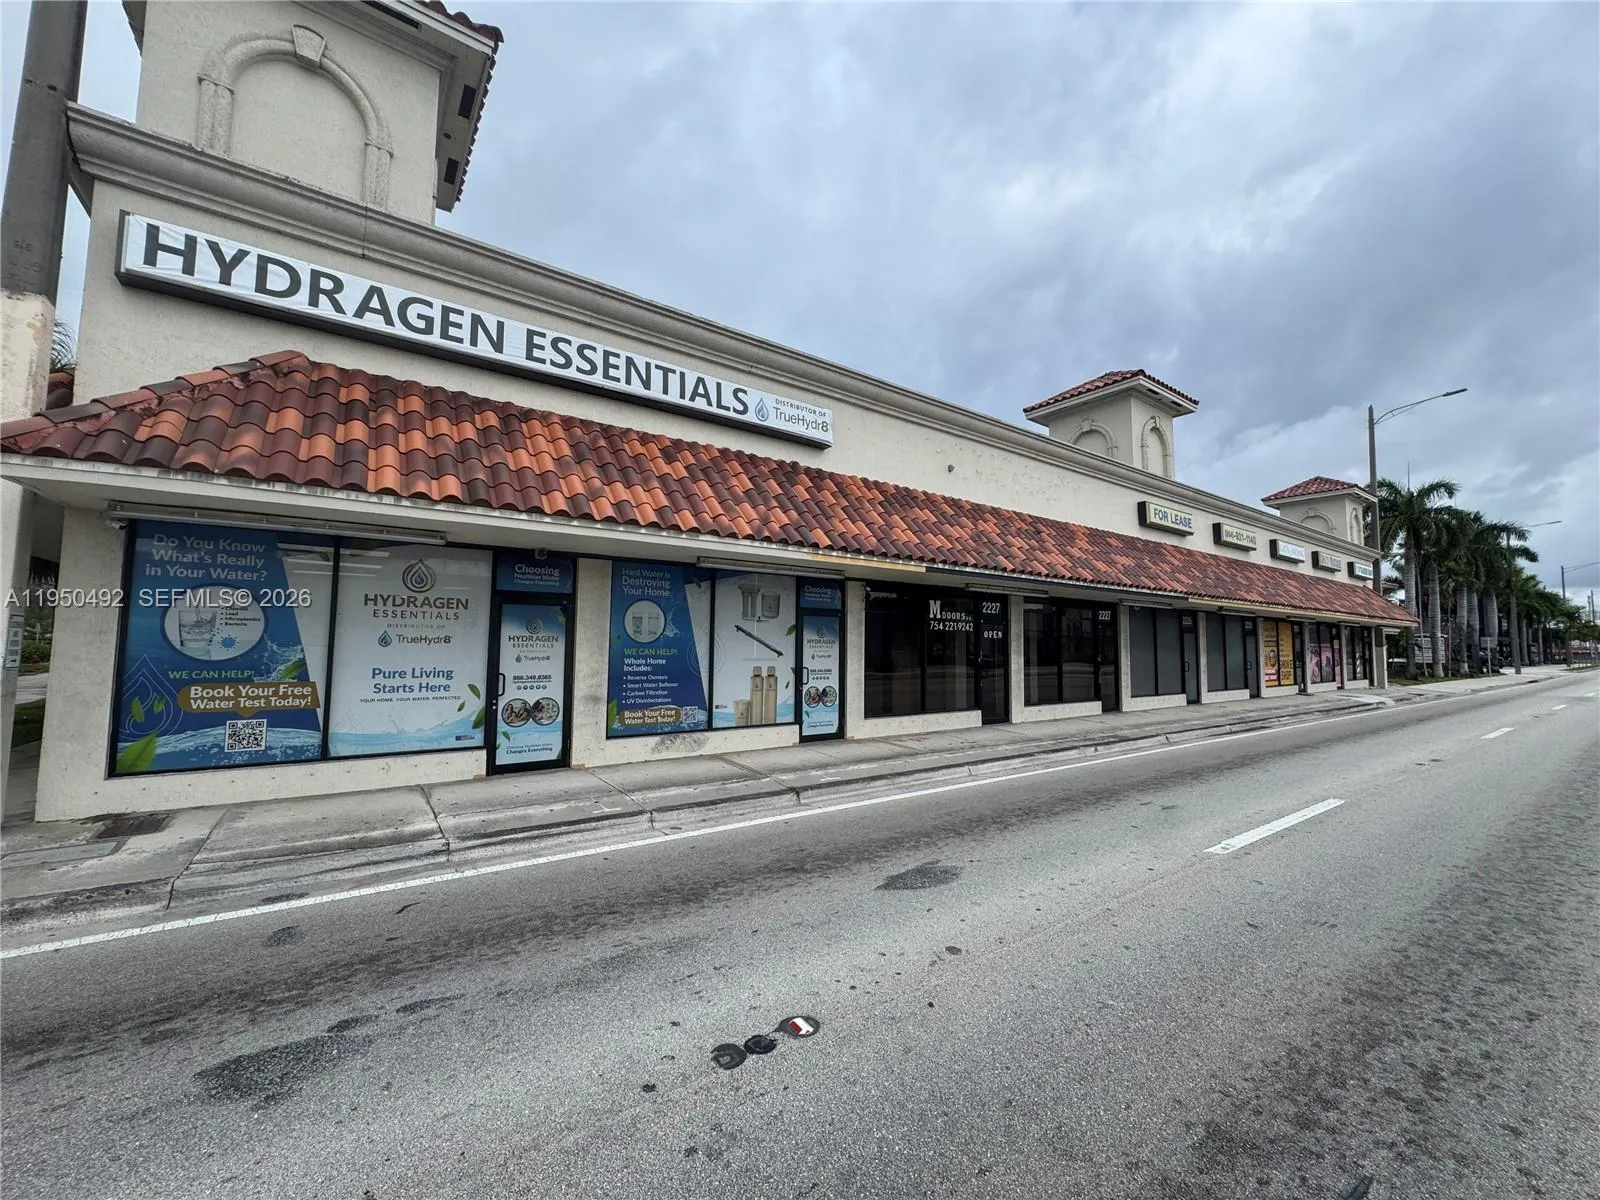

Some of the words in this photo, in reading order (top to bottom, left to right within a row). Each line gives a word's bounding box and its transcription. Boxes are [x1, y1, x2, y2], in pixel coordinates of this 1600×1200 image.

[143, 222, 505, 354] HYDRAGEN
[525, 327, 749, 416] ESSENTIALS
[775, 398, 816, 414] DISTRIBUTOR
[773, 406, 829, 433] TrueHydr8
[1153, 507, 1169, 523] FOR
[1170, 512, 1193, 529] LEASE
[153, 534, 178, 547] Do
[183, 536, 214, 549] You
[219, 539, 266, 553] Know
[151, 548, 212, 564] What's
[216, 553, 265, 568] Really
[145, 563, 161, 577] in
[166, 564, 206, 578] Your
[210, 567, 268, 582] Water?
[515, 563, 560, 576] Choosing
[622, 568, 641, 576] Hard
[641, 569, 664, 578] Water
[622, 575, 671, 589] Destroying
[622, 586, 643, 595] Your
[364, 593, 469, 610] HYDRAGEN
[982, 601, 1000, 614] 2227
[373, 608, 460, 620] ESSENTIALS
[1099, 610, 1112, 621] 2227
[396, 634, 451, 646] TrueHydr8
[983, 630, 1003, 638] OPEN
[657, 648, 678, 656] HELP!
[168, 670, 189, 679] WE
[192, 670, 219, 679] CAN
[222, 670, 255, 678] HELP!
[372, 667, 407, 679] Pure
[411, 666, 454, 680] Living
[190, 685, 234, 698] Book
[238, 685, 275, 697] Your
[279, 684, 312, 695] Free
[373, 683, 415, 694] Starts
[418, 682, 451, 693] Here
[190, 699, 235, 709] Water
[238, 698, 266, 708] Test
[268, 697, 312, 708] Today!
[624, 710, 644, 718] Book
